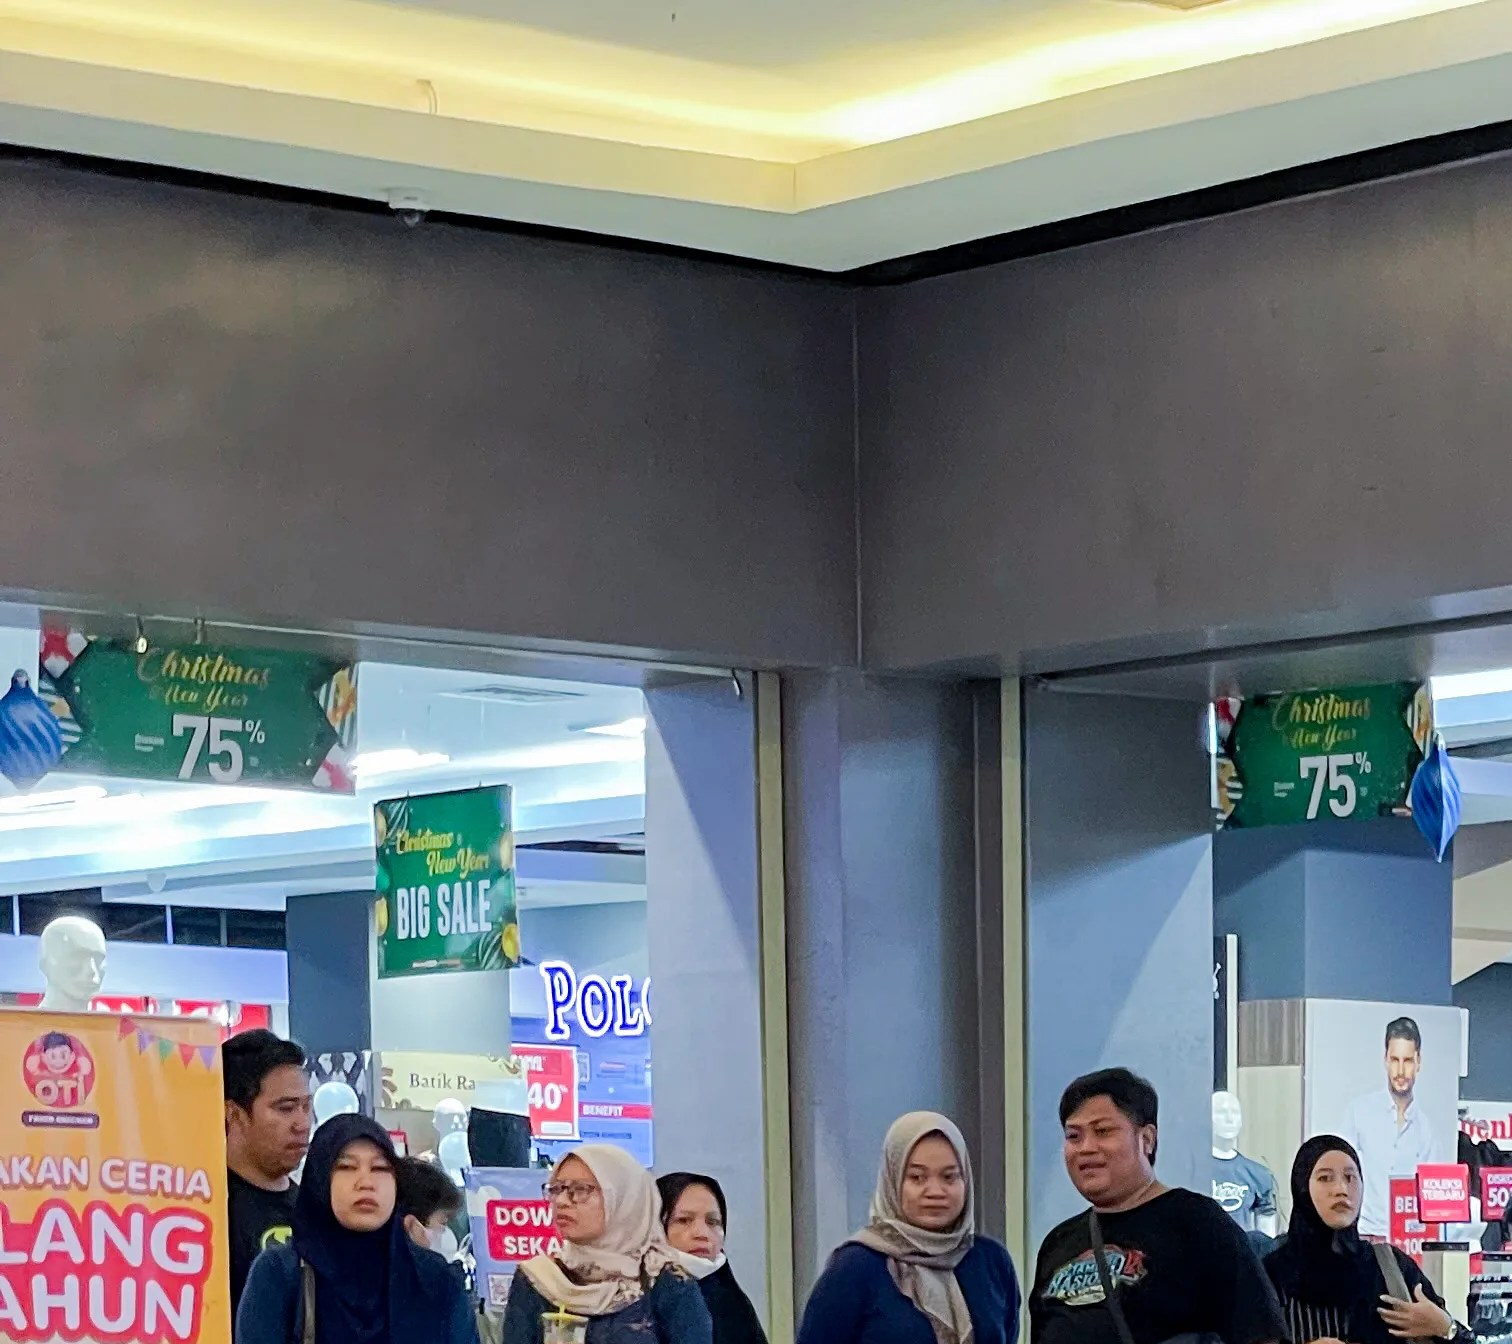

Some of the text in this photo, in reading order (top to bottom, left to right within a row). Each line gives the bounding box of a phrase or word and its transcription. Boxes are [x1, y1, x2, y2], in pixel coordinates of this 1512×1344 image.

[396, 829, 454, 854] Christmas
[426, 847, 489, 878] New Year
[396, 879, 492, 940] BIG SALE
[540, 960, 651, 1040] POL
[409, 1072, 476, 1092] Batik Ra
[100, 1159, 211, 1199] CERIA
[494, 1206, 553, 1228] DOW
[1394, 1196, 1418, 1213] BEL
[503, 1234, 566, 1257] SEKA
